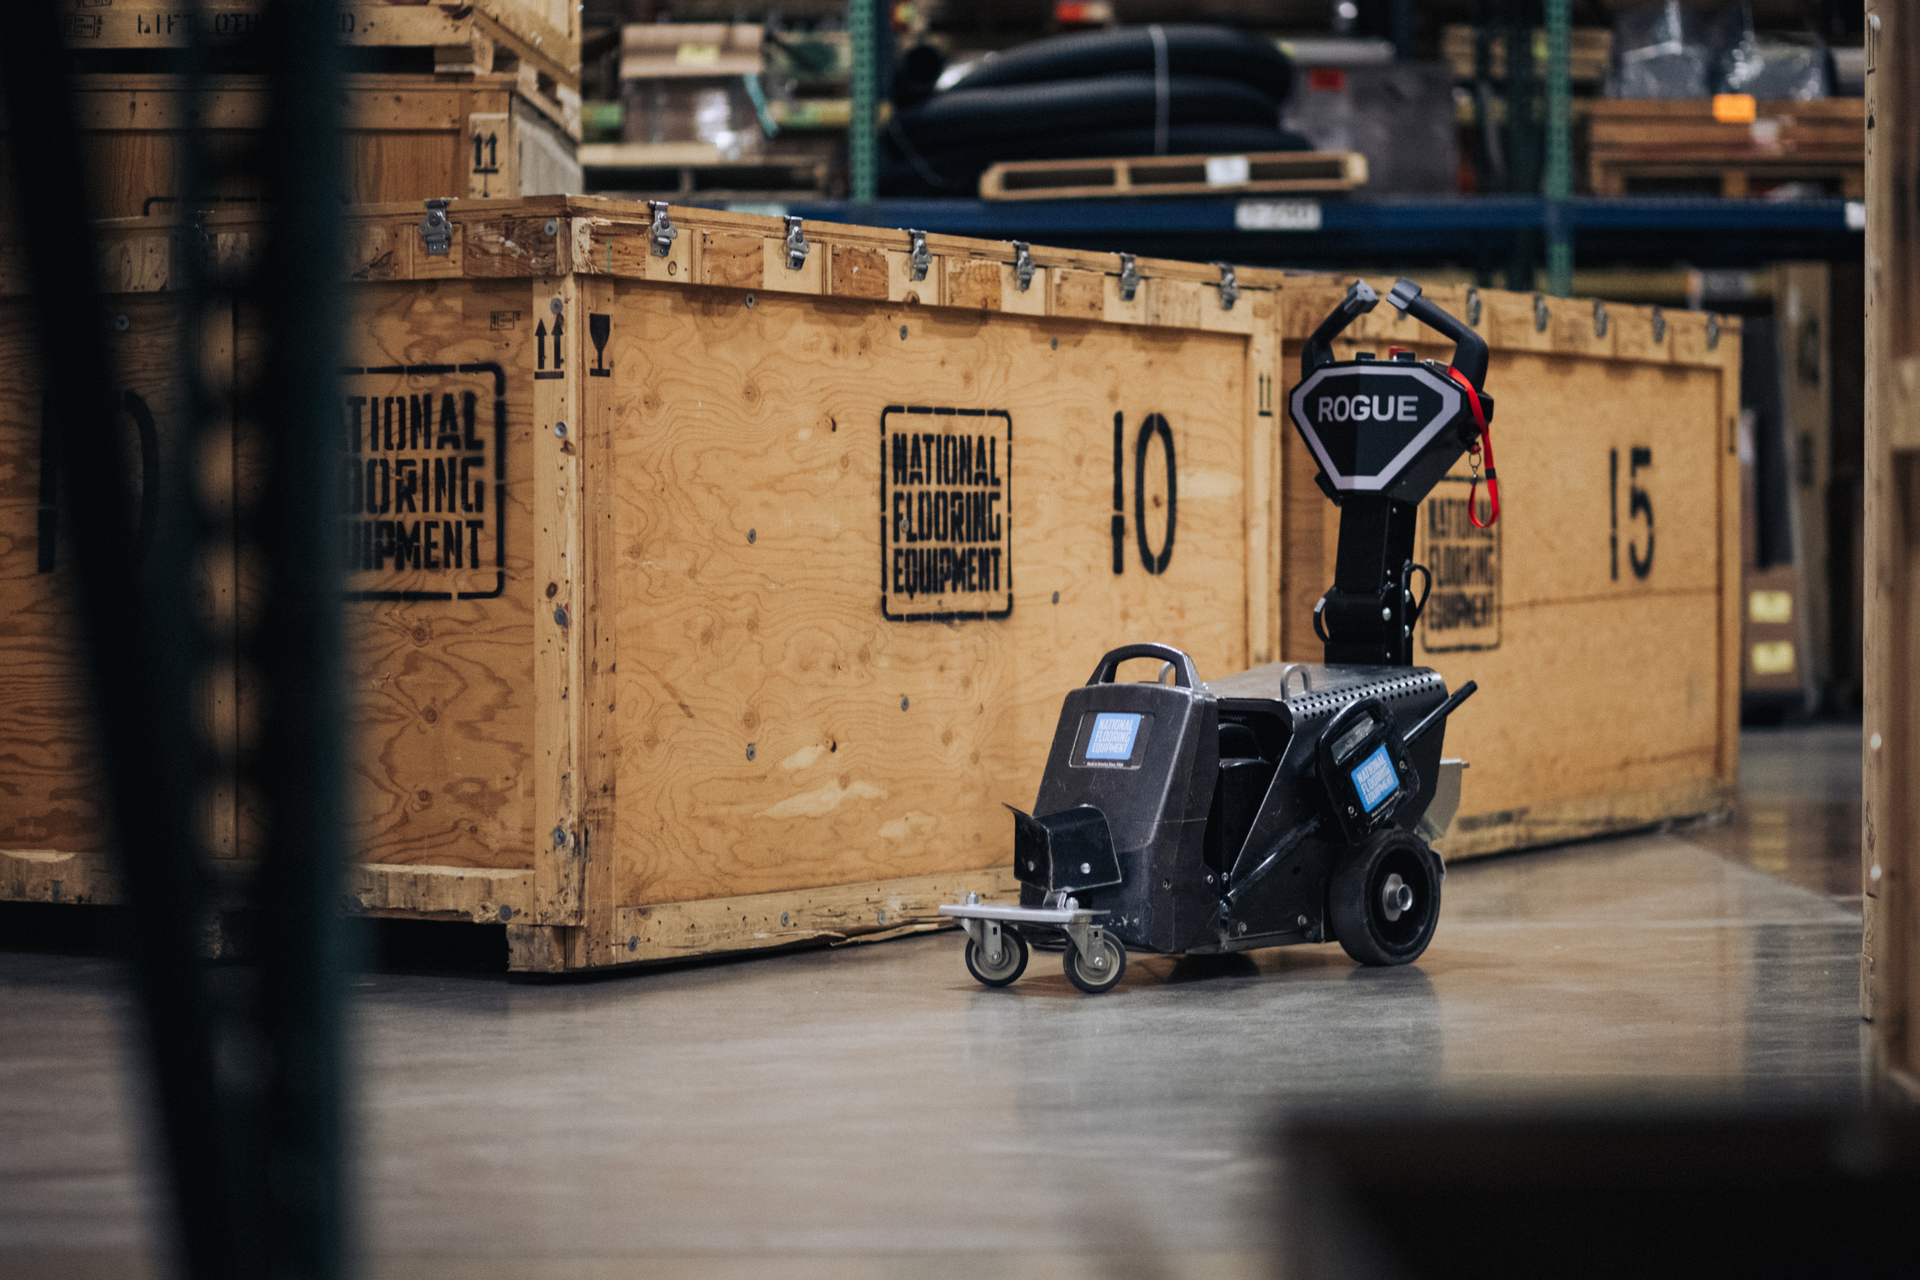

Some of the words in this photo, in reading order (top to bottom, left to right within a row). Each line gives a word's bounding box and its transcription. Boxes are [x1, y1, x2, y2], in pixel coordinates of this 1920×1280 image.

[1318, 395, 1419, 422] ROGUE
[893, 433, 1001, 486] NATIONAL
[340, 457, 484, 514] OORING
[1111, 411, 1177, 575] 10
[893, 491, 1001, 543] FLOORING
[1610, 446, 1654, 581] 15
[893, 547, 1001, 600] EQUIPMENT
[1429, 545, 1494, 588] FLOORING
[1095, 730, 1131, 743] FLOORING
[1098, 719, 1133, 731] NATIONAL
[1091, 743, 1128, 754] EQUIPMENT
[1357, 753, 1387, 785] NATIONAL
[1361, 763, 1391, 796] FLOORING
[1365, 774, 1394, 805] EQUIPMENT
